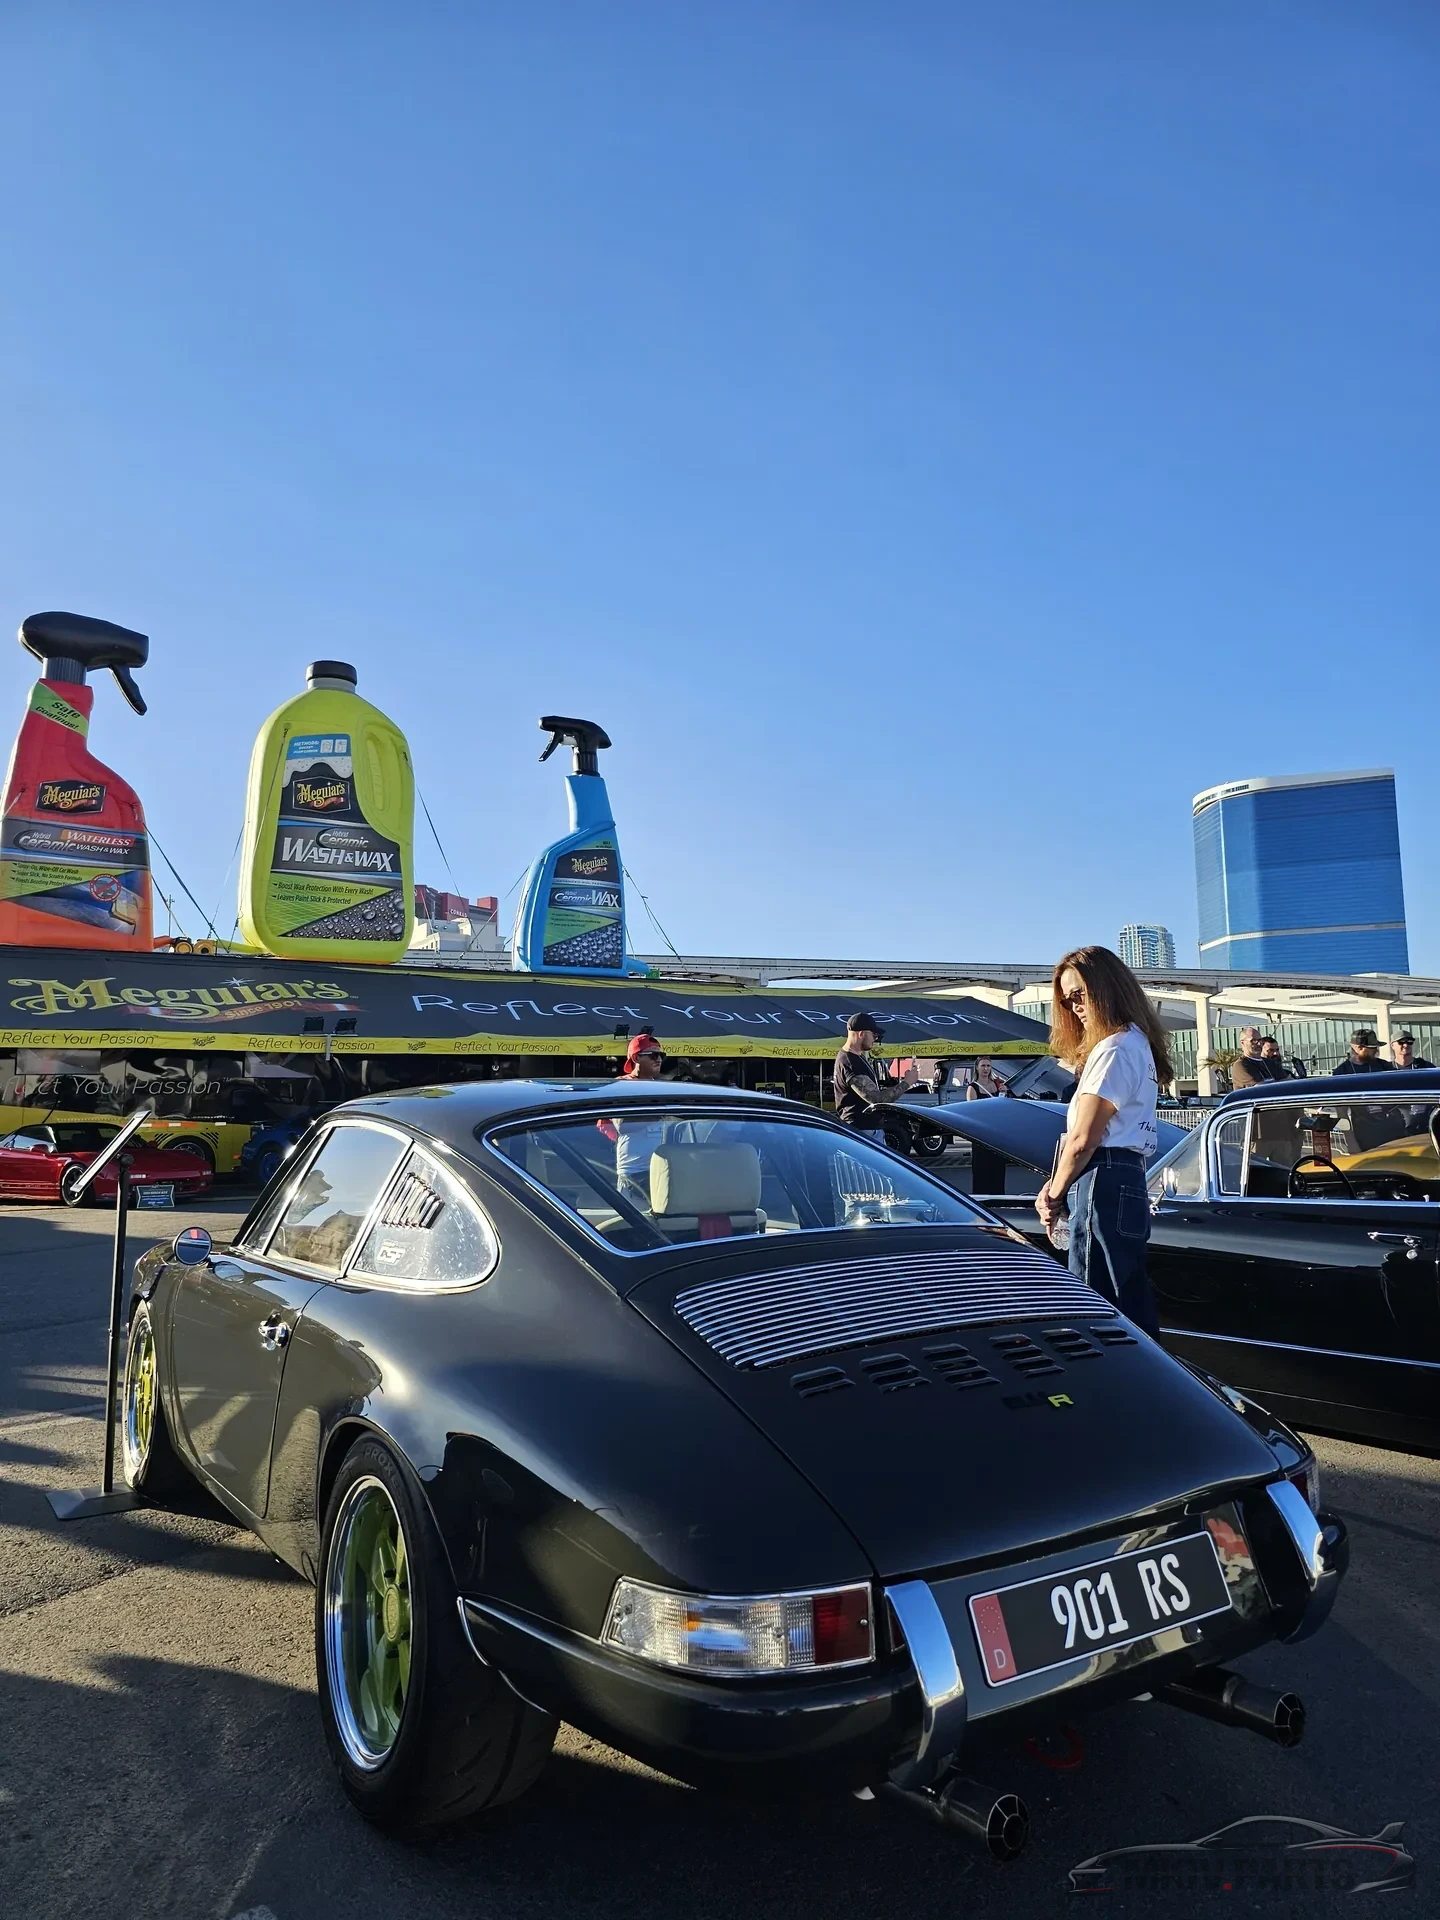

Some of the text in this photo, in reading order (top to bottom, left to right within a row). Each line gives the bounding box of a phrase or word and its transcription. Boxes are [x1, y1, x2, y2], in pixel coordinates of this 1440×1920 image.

[51, 701, 81, 718] Safe
[42, 785, 101, 809] Meguiar's
[296, 781, 346, 808] Meguiar's
[32, 831, 52, 840] Hybrid
[67, 831, 132, 846] WATERLESS
[319, 833, 369, 848] Ceramic
[19, 835, 77, 852] Ceramic
[305, 884, 332, 892] Protection
[344, 886, 358, 895] Every
[591, 889, 620, 909] WAX
[8, 977, 349, 1019] Meguiar's
[224, 1005, 263, 1020] Since
[411, 994, 649, 1021] Reflect
[660, 1004, 781, 1025] Your
[2, 1032, 56, 1045] Reflect
[63, 1033, 97, 1045] Your
[248, 1037, 293, 1050] Reflect
[299, 1039, 326, 1050] Your
[453, 1041, 492, 1053] Reflect
[496, 1042, 519, 1053] Your
[661, 1044, 682, 1054] Your
[772, 1046, 800, 1057] Reflect
[803, 1047, 820, 1057] Your
[902, 1045, 928, 1055] Reflect
[929, 1045, 947, 1054] Your
[72, 1077, 120, 1095] Your
[1050, 1553, 1191, 1649] 901 RS
[993, 1648, 1006, 1669] D
